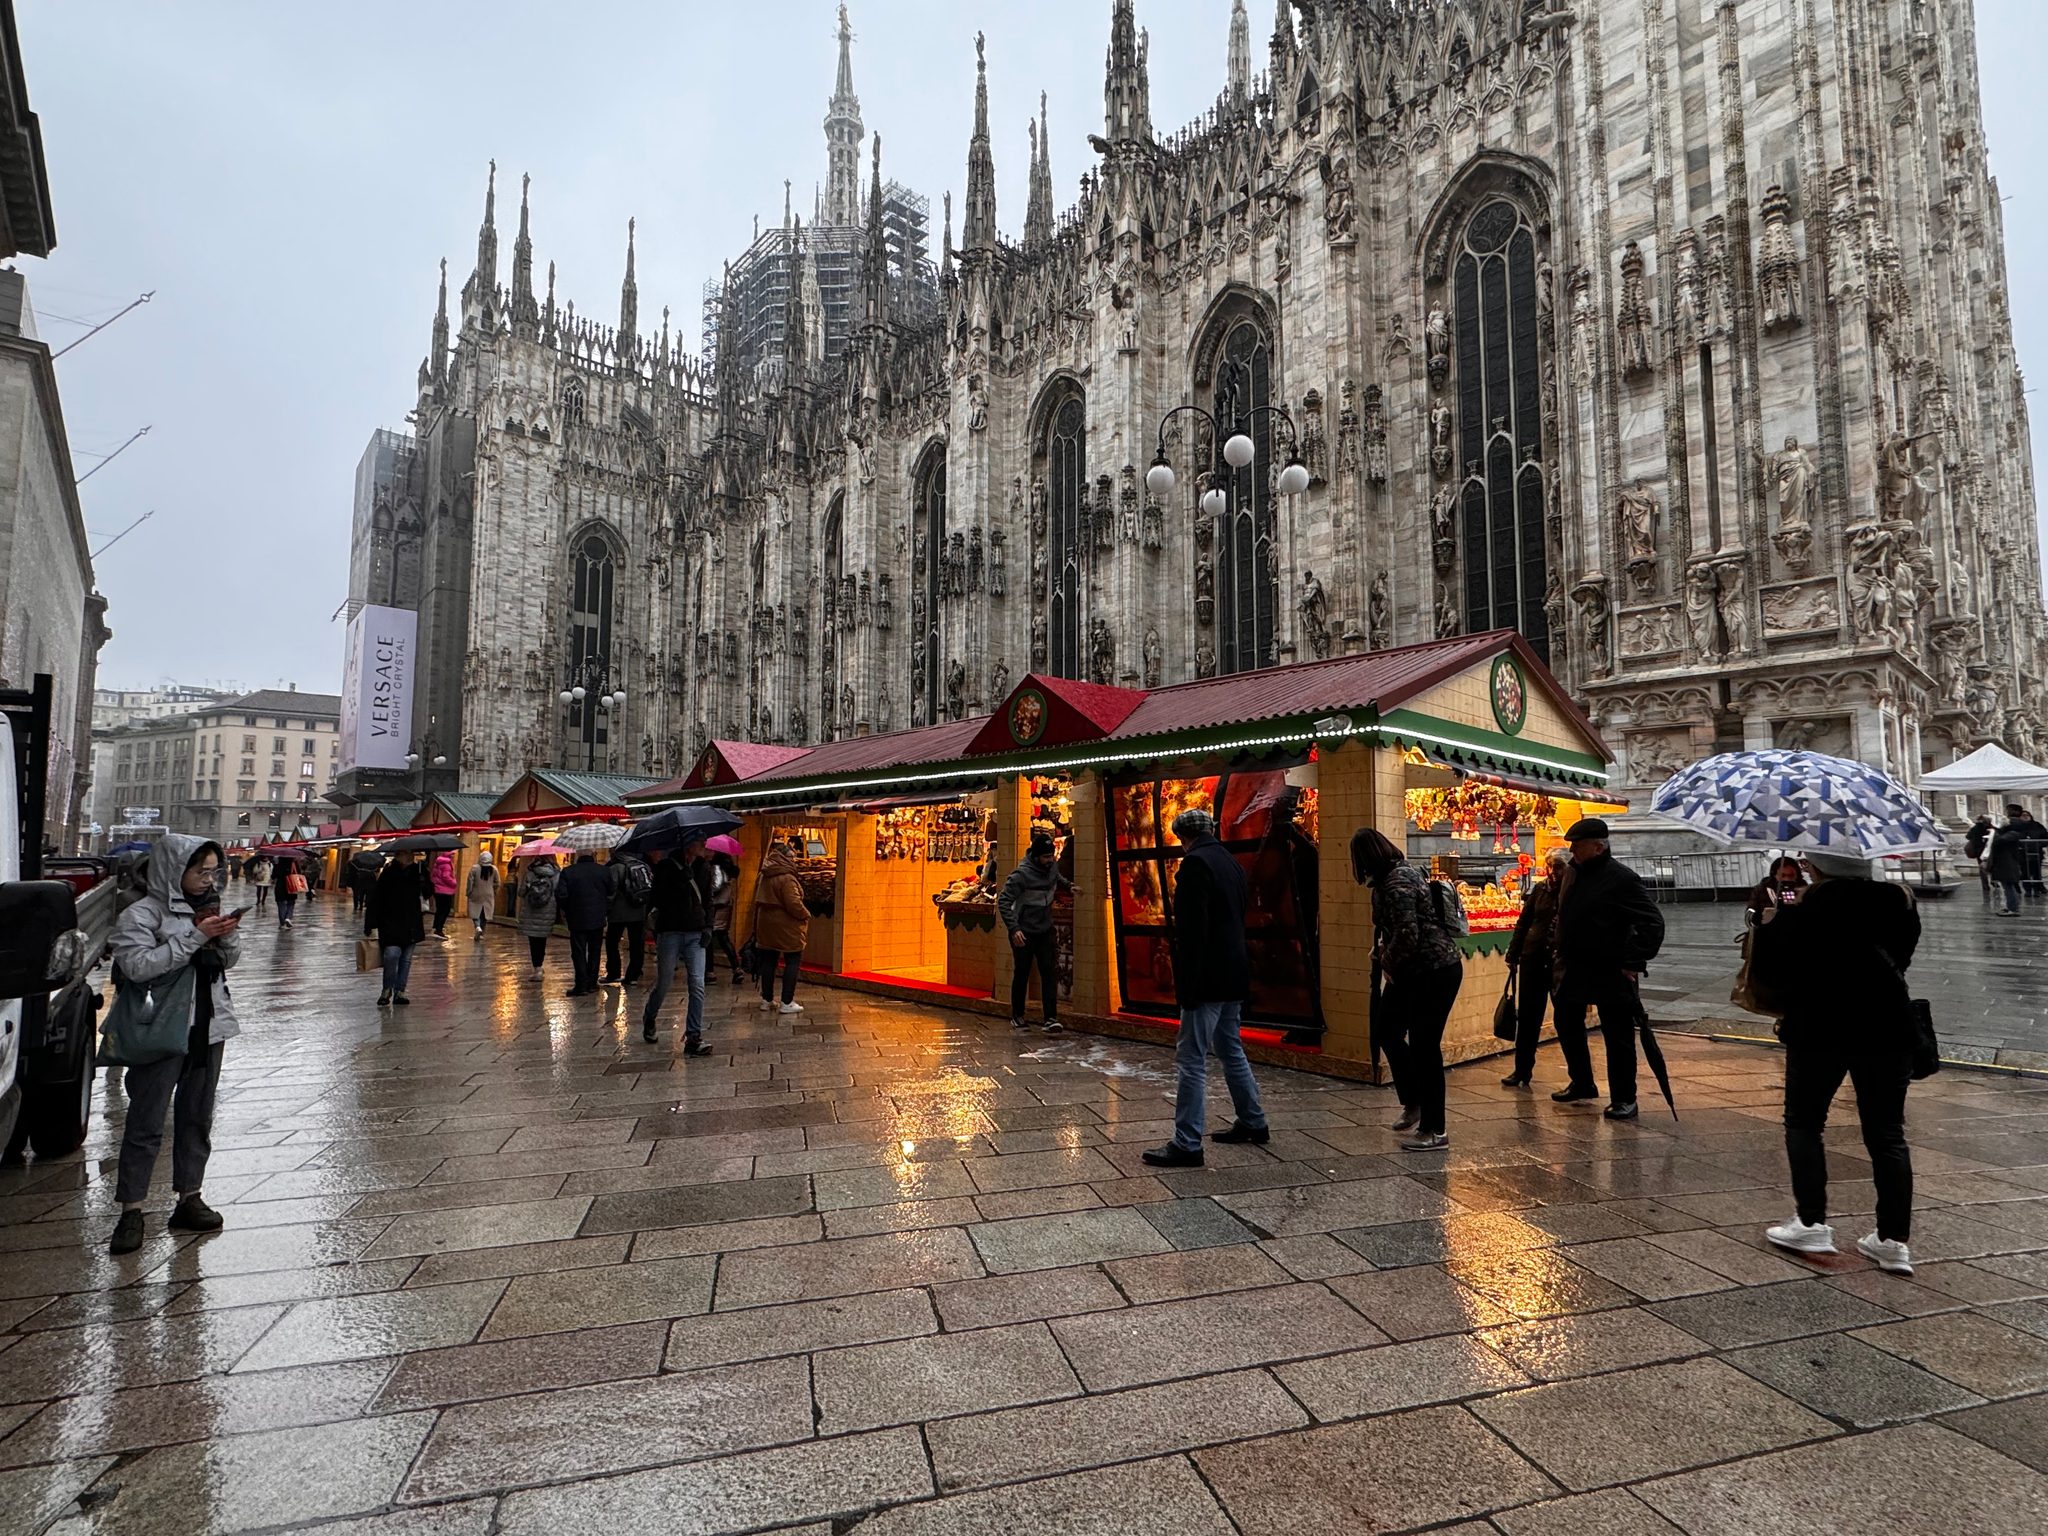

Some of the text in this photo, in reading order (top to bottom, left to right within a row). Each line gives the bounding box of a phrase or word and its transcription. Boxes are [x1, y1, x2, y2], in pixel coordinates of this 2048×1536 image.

[371, 635, 393, 737] VERSACE
[390, 638, 406, 737] BRIGHT CRYSTAL
